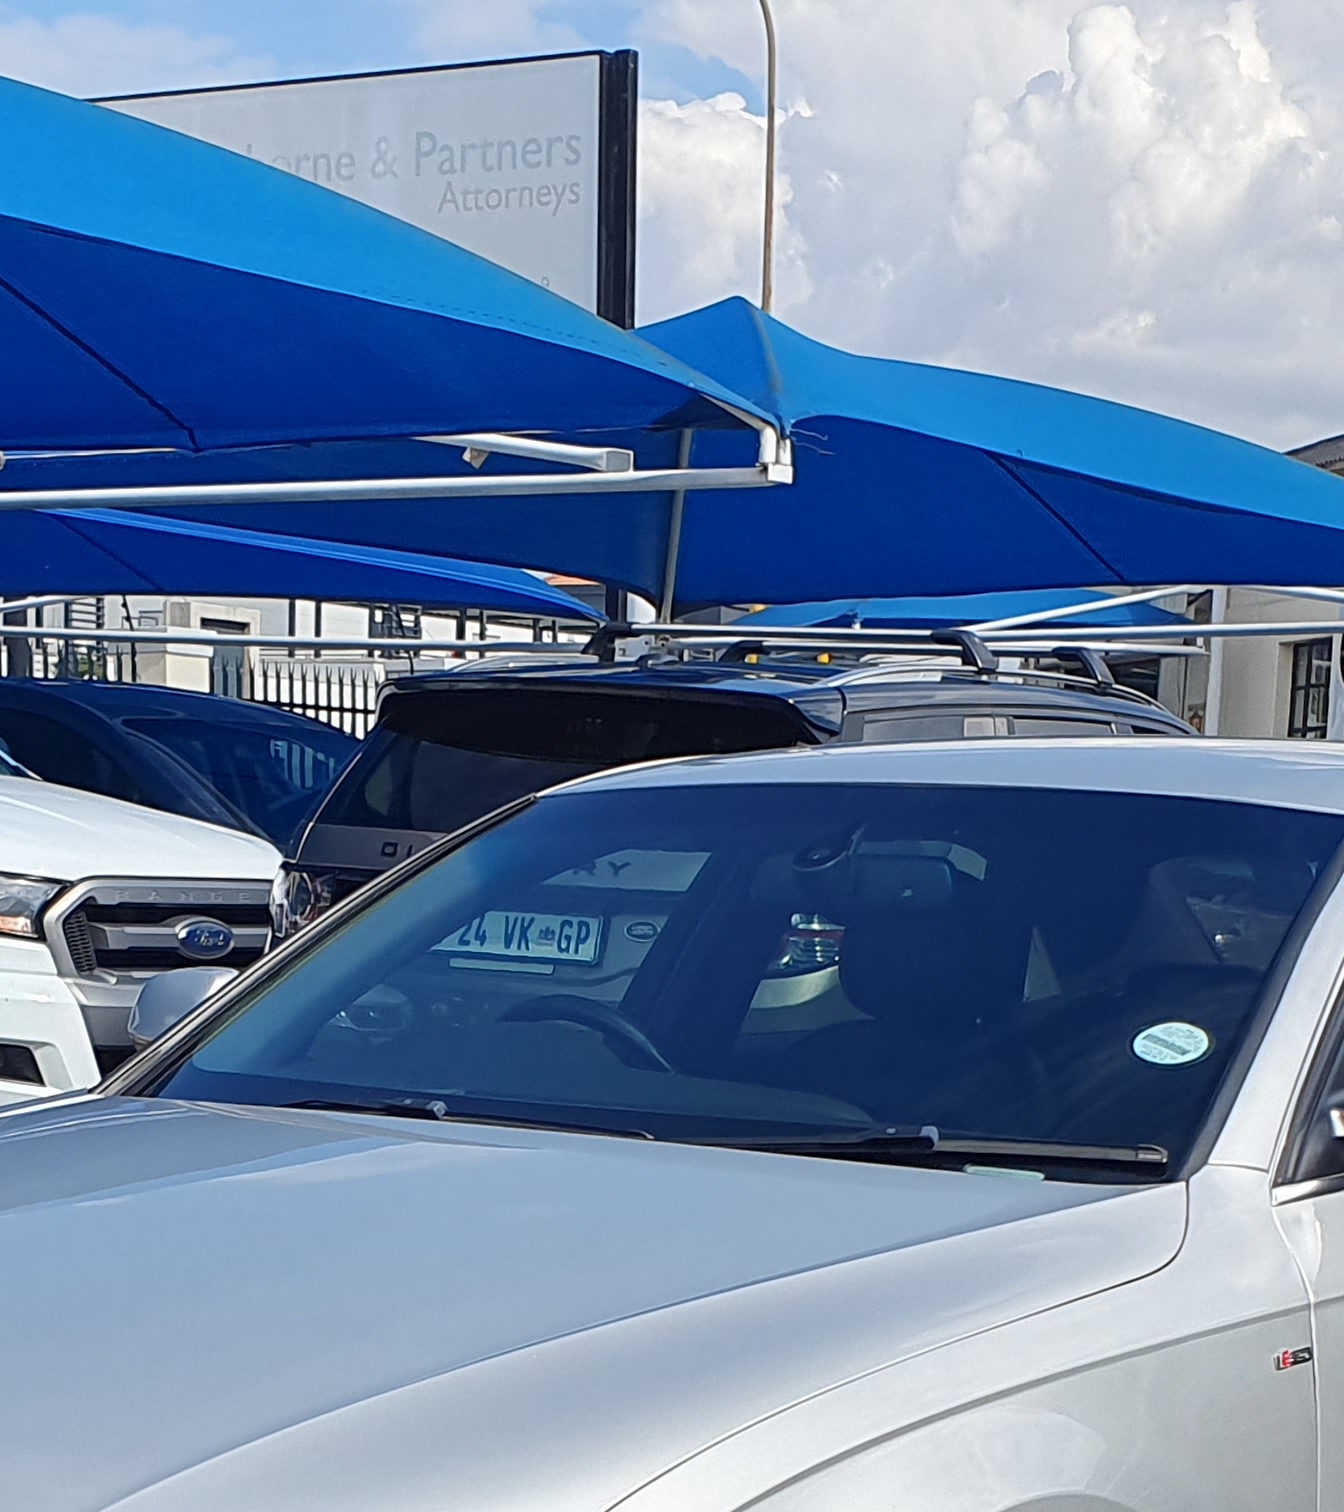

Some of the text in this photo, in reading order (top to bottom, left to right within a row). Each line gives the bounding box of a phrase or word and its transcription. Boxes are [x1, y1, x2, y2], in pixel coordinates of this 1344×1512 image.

[246, 130, 582, 182] orne & Partners
[437, 180, 582, 217] Attorneys
[504, 914, 536, 952] VK
[556, 919, 591, 955] GP
